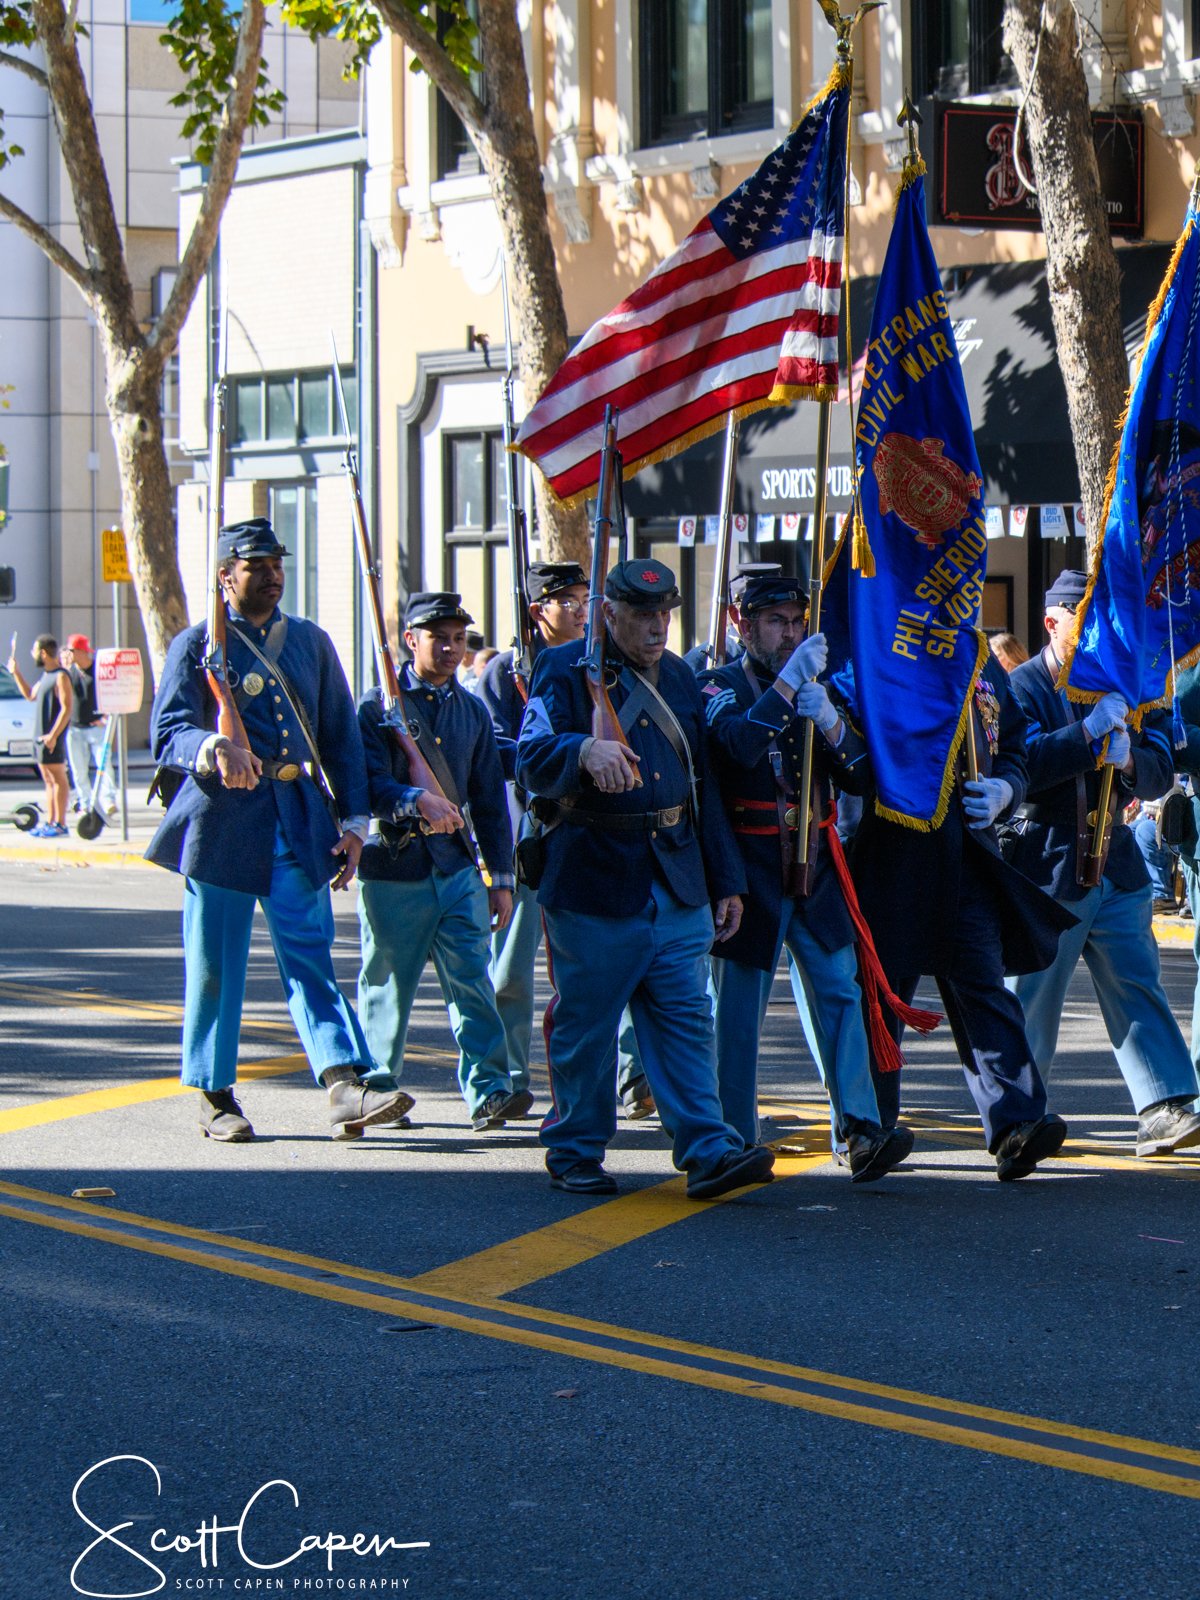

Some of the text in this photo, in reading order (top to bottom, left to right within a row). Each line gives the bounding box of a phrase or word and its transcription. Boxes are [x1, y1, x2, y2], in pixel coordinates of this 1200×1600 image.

[856, 332, 954, 446] CIVIL WAR
[761, 468, 816, 500] SPORTS
[1043, 515, 1061, 524] LIGHT
[1045, 507, 1058, 515] BUD
[892, 609, 930, 660] PHIL
[915, 508, 986, 606] SHERIDA
[99, 665, 116, 679] NO
[521, 708, 538, 735] 2
